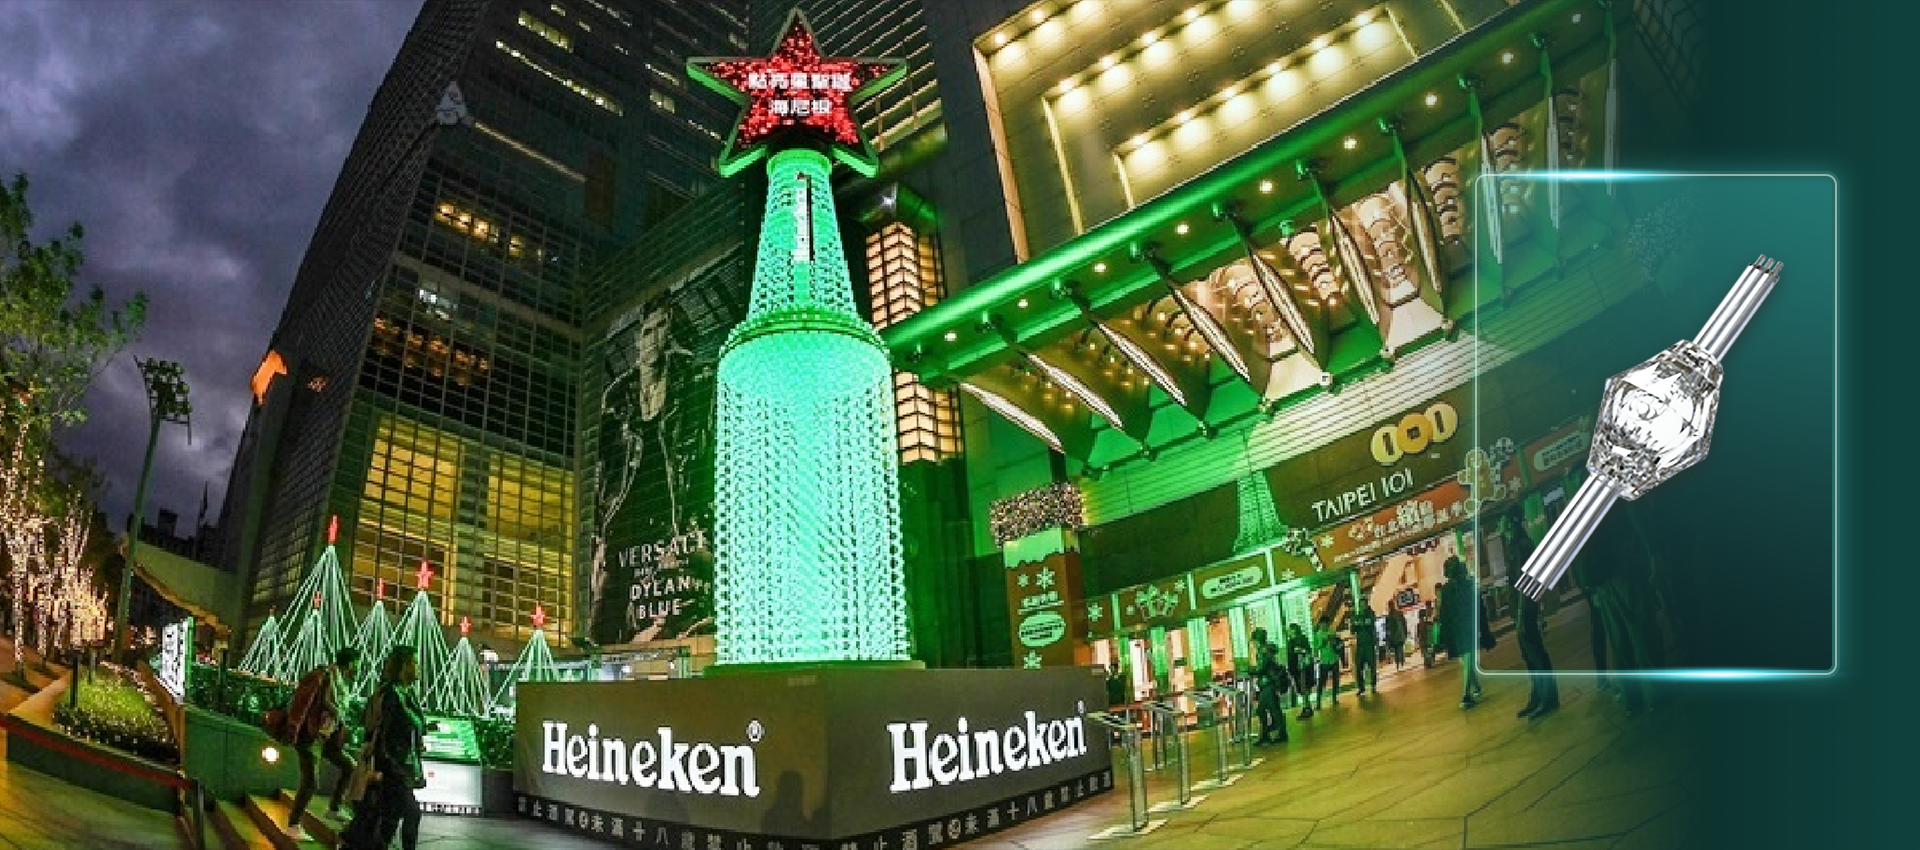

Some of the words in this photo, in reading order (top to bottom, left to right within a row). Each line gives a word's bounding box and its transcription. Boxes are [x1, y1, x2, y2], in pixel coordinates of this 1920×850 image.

[1311, 481, 1376, 522] TAIPEI
[630, 575, 691, 601] DYLAN
[638, 598, 683, 619] BLUE
